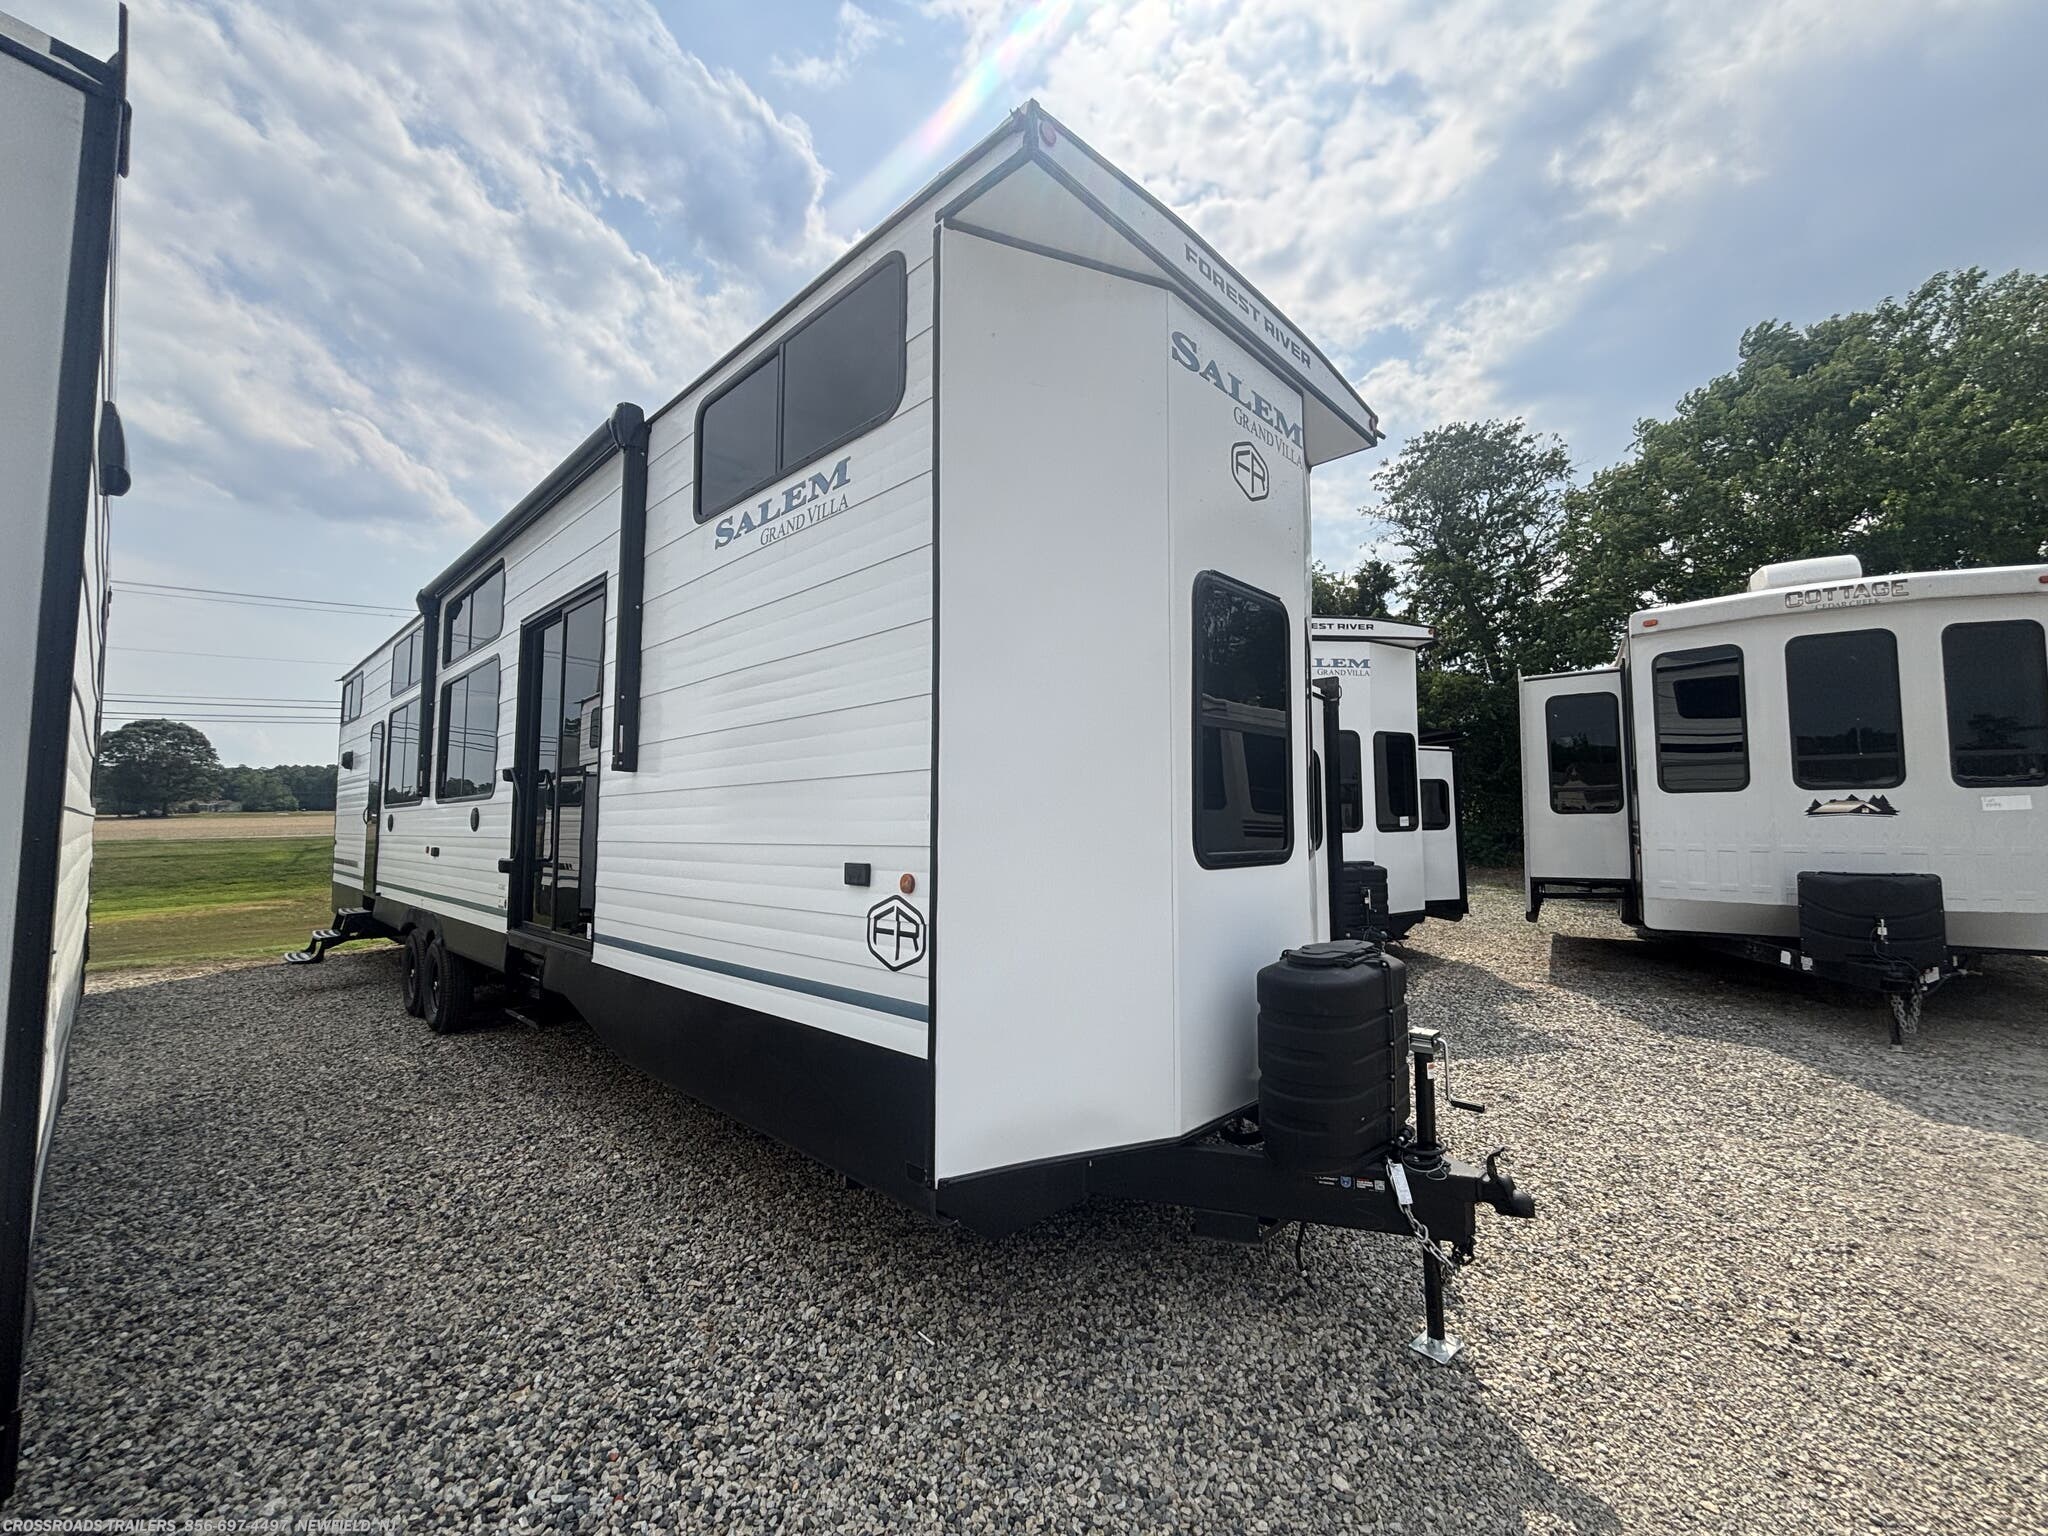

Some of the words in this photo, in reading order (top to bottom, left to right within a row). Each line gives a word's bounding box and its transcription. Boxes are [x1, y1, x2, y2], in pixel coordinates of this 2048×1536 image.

[1184, 243, 1261, 321] FOREST
[1264, 316, 1312, 370] RIVER
[1171, 331, 1304, 450] SALEM
[1233, 406, 1275, 448] GRAND
[1275, 436, 1304, 470] VILLA
[715, 456, 852, 550] SALEM
[760, 514, 806, 546] GRAND
[807, 493, 849, 524] VILLA
[1784, 578, 1910, 609] COTTAGE
[1312, 658, 1371, 668] LEM
[1317, 668, 1346, 676] GRAND
[1346, 668, 1370, 677] VILLA
